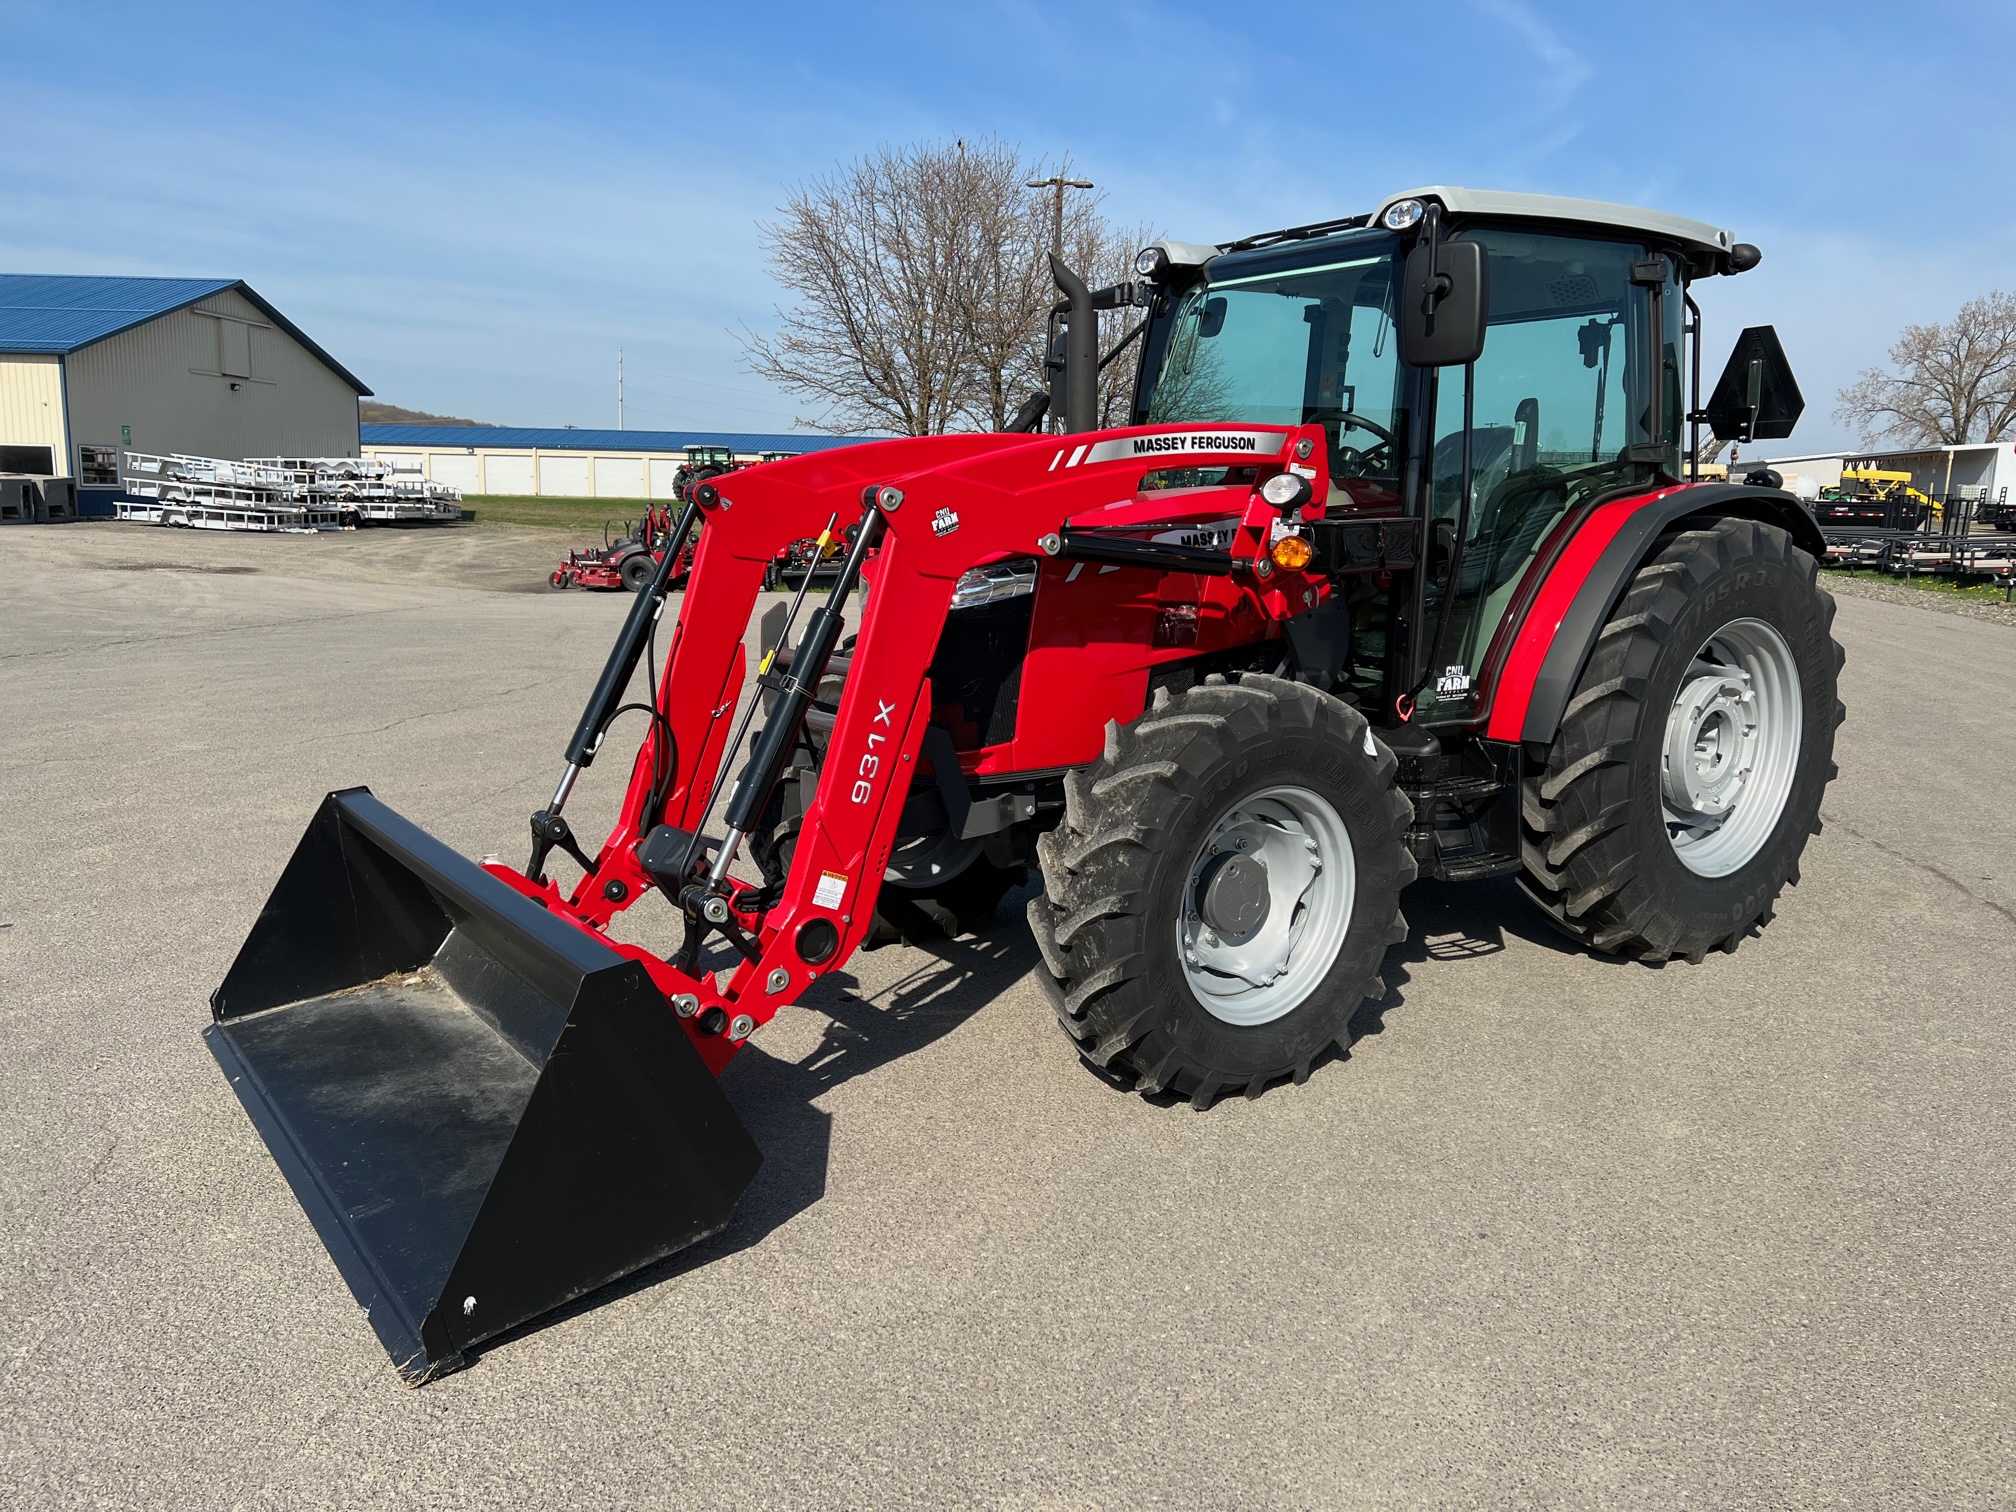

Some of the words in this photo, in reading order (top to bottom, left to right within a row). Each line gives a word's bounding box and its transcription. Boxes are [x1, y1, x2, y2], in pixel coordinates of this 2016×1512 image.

[1133, 436, 1187, 454] MASSEY
[1190, 436, 1256, 451] FERGUSON
[931, 511, 959, 532] FARM
[1436, 675, 1470, 691] FARM
[851, 732, 886, 804] 931
[872, 697, 896, 728] X
